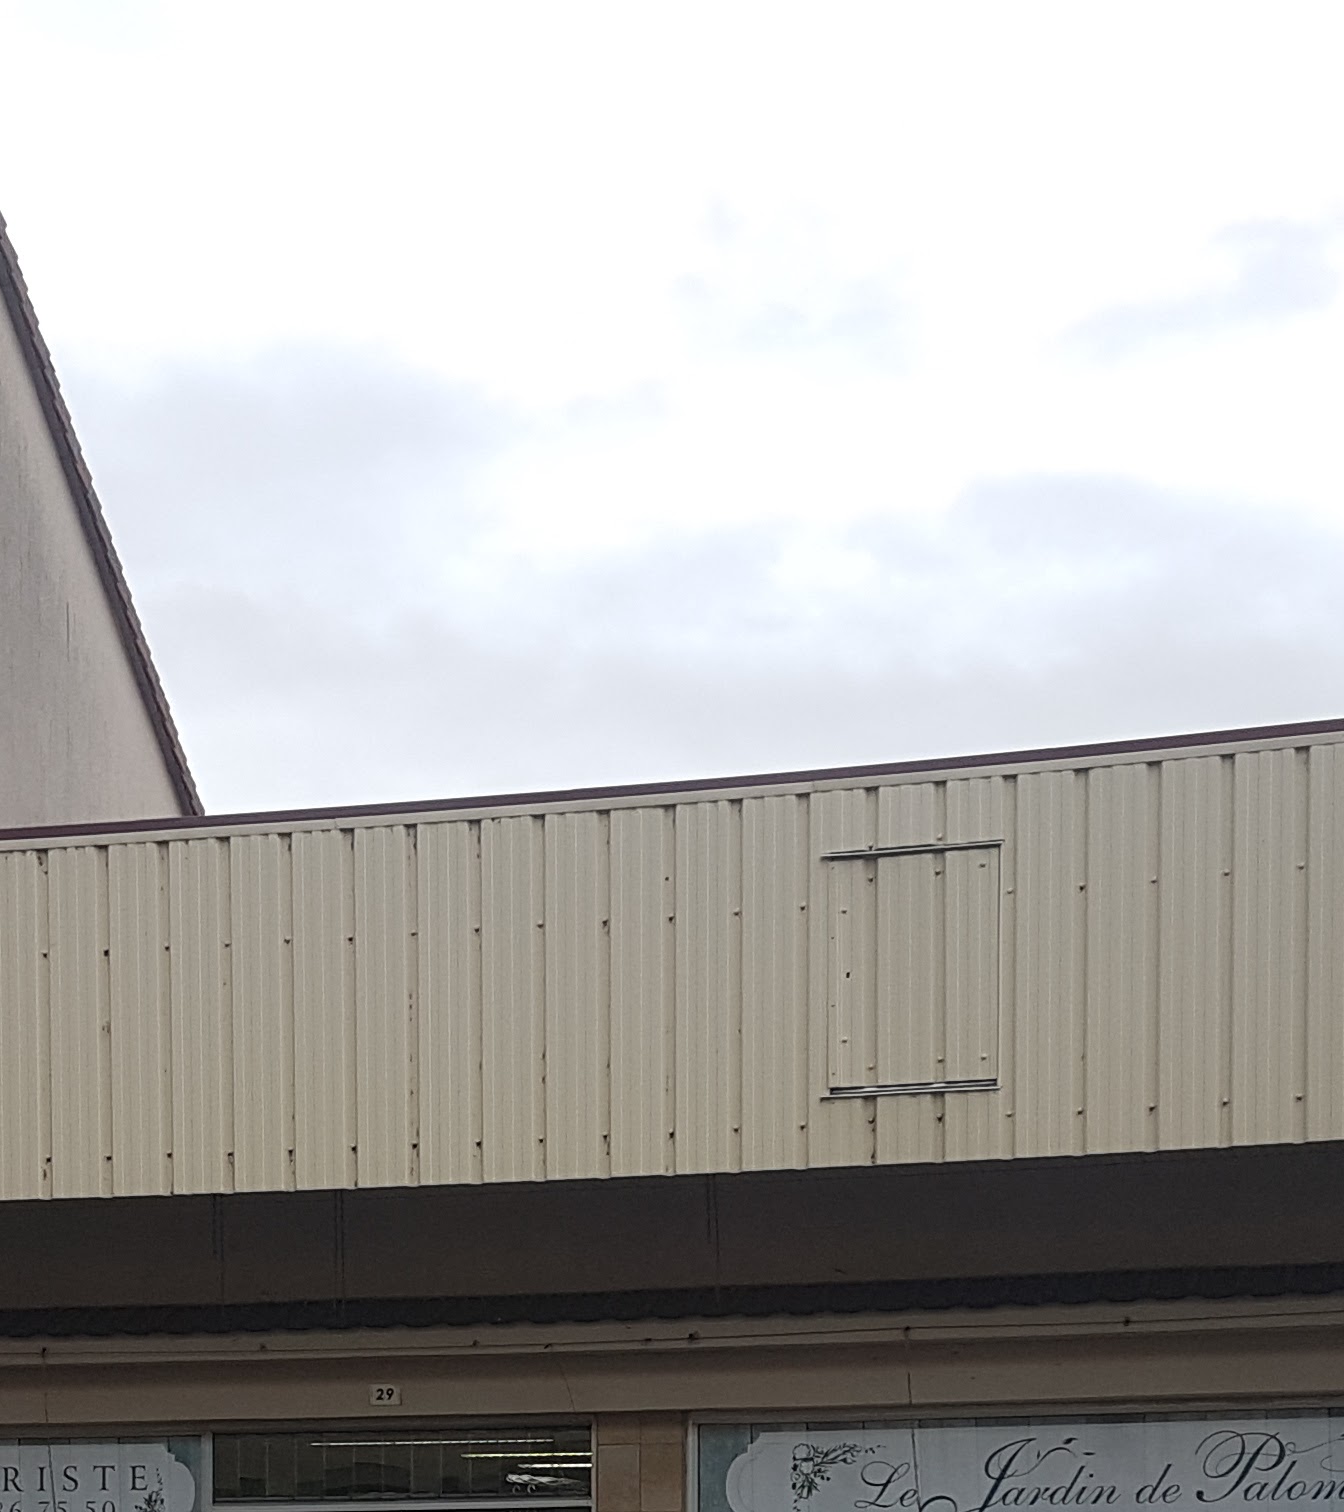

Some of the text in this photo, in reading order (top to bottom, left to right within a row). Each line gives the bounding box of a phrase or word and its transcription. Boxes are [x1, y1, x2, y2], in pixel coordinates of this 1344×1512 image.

[376, 1388, 395, 1400] 29
[854, 1460, 919, 1509] Le
[1134, 1462, 1183, 1504] de
